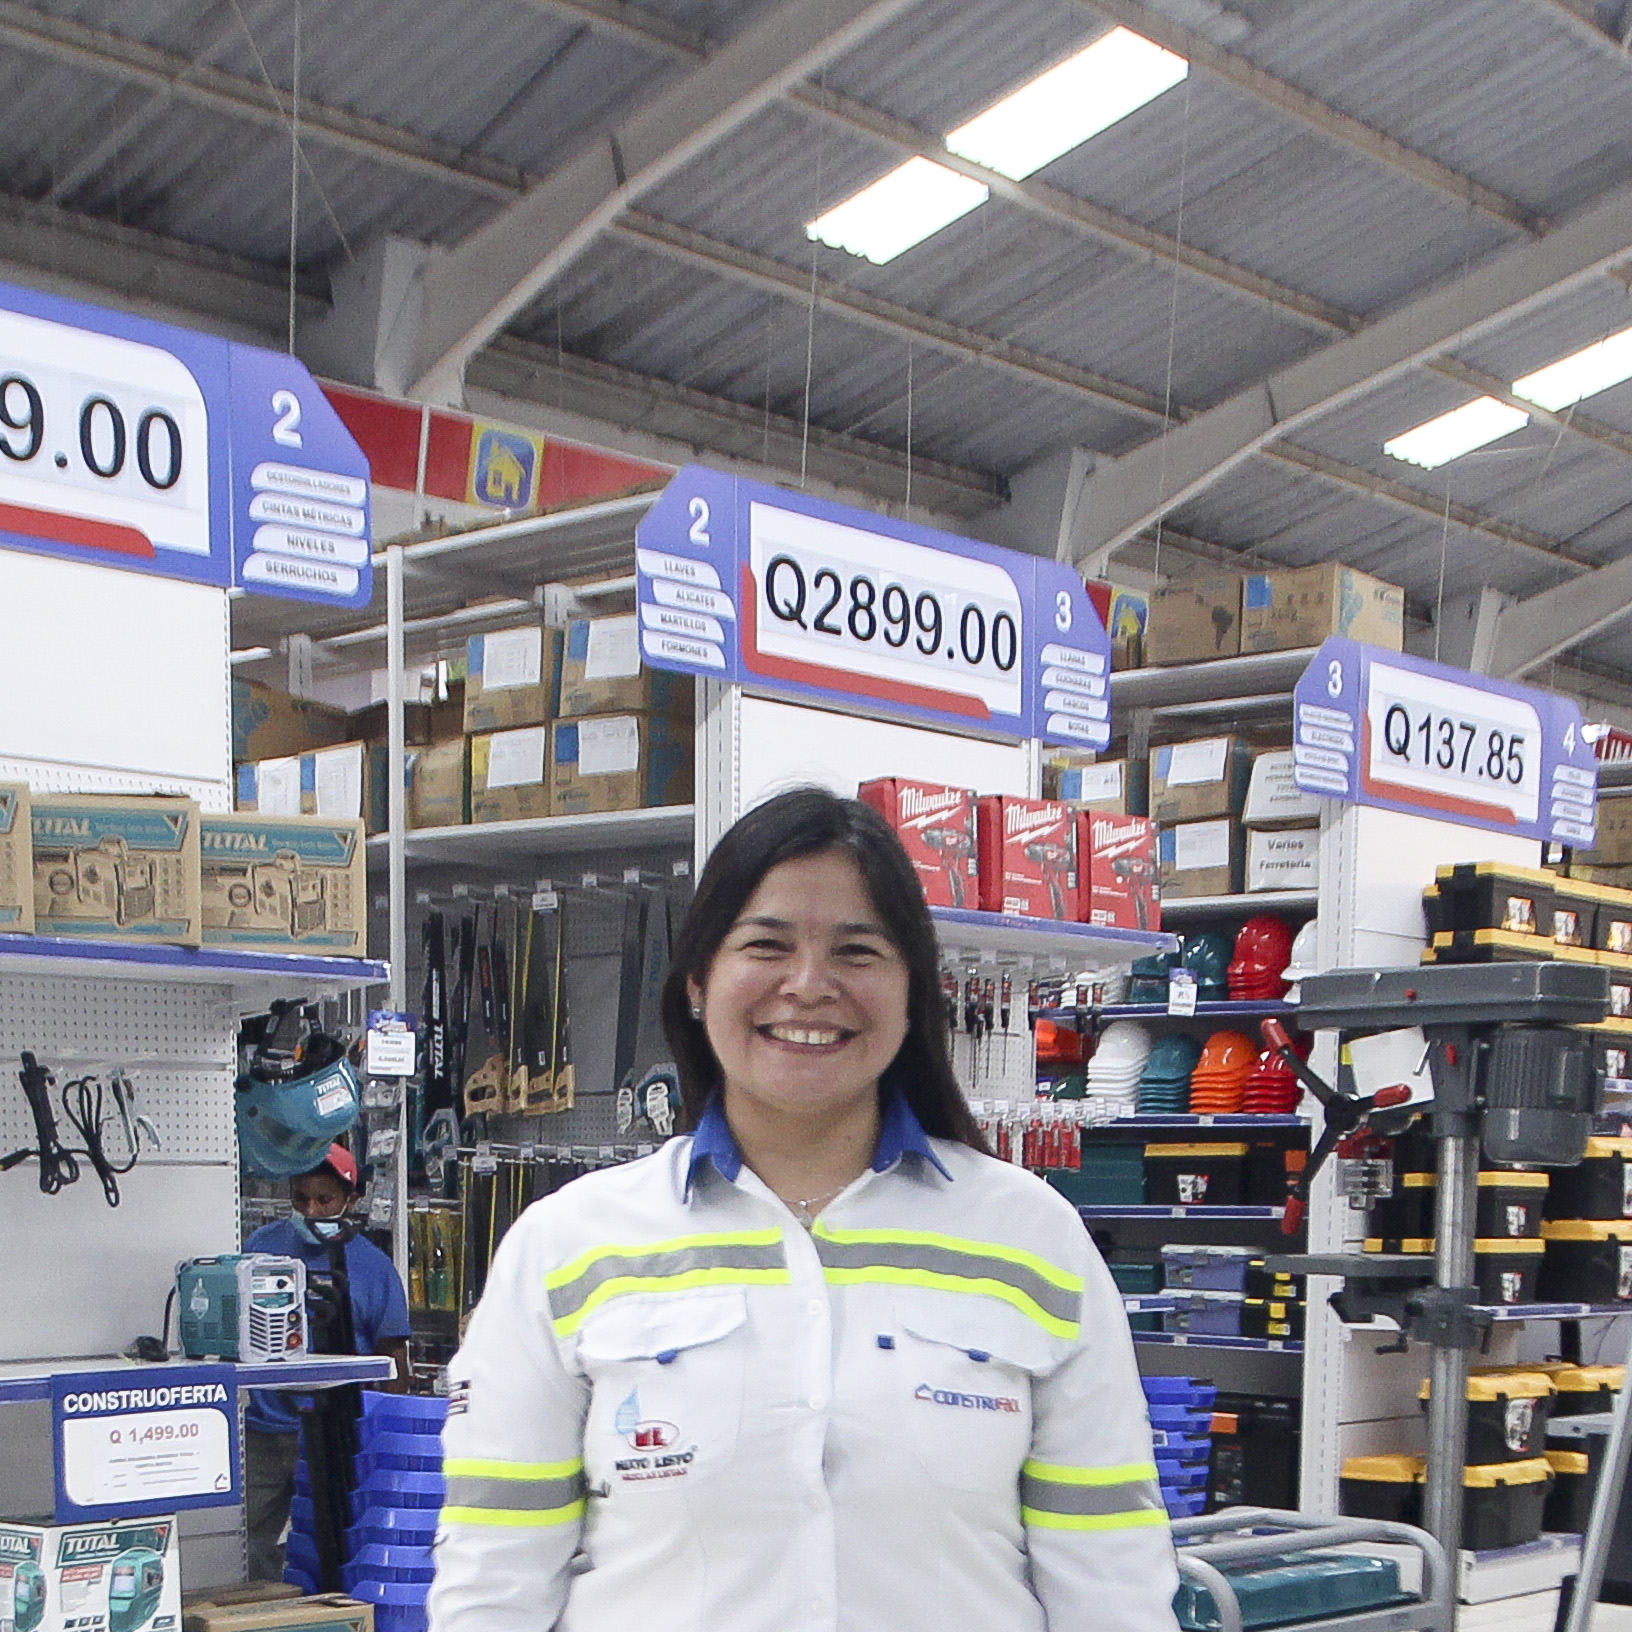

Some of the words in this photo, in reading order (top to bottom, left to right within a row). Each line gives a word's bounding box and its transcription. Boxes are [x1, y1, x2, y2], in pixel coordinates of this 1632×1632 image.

[272, 389, 303, 449] 2
[262, 499, 300, 518] CINTAS
[688, 497, 711, 546] 2
[286, 533, 336, 554] NIVELES
[264, 560, 338, 583] SERRUCHOS
[660, 613, 707, 632] MARTILLOS
[764, 552, 1018, 672] Q2899.00
[1055, 590, 1072, 633] 3
[1327, 659, 1343, 697] 3
[1384, 702, 1525, 785] Q137.85
[1562, 722, 1576, 758] 4
[898, 786, 962, 819] Milwaukee
[1005, 801, 1062, 834] Milwaukee
[1092, 818, 1146, 850] Milwaukee
[63, 1383, 228, 1413] CONSTRUOFERTA
[109, 1429, 122, 1445] Q
[66, 1533, 121, 1555] TOTAL
